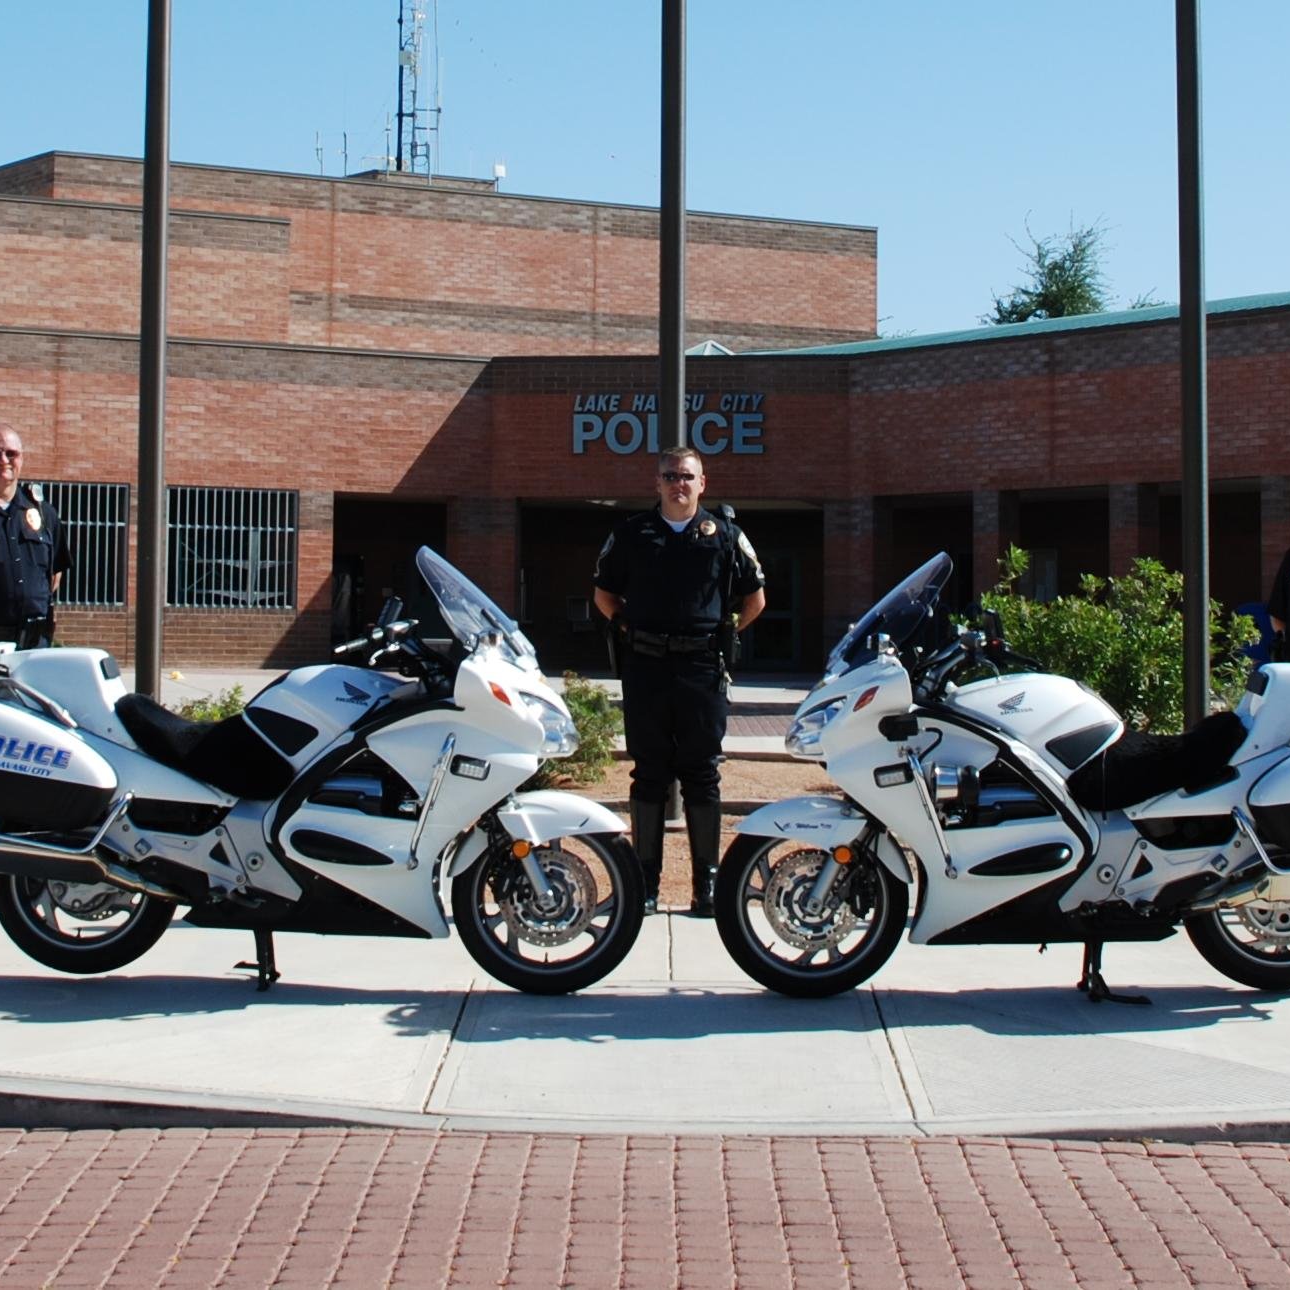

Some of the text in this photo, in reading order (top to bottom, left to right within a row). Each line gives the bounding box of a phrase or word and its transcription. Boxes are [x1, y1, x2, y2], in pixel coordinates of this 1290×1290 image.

[574, 394, 621, 412] LAKE
[720, 394, 764, 412] CITY
[30, 766, 53, 777] CITY
